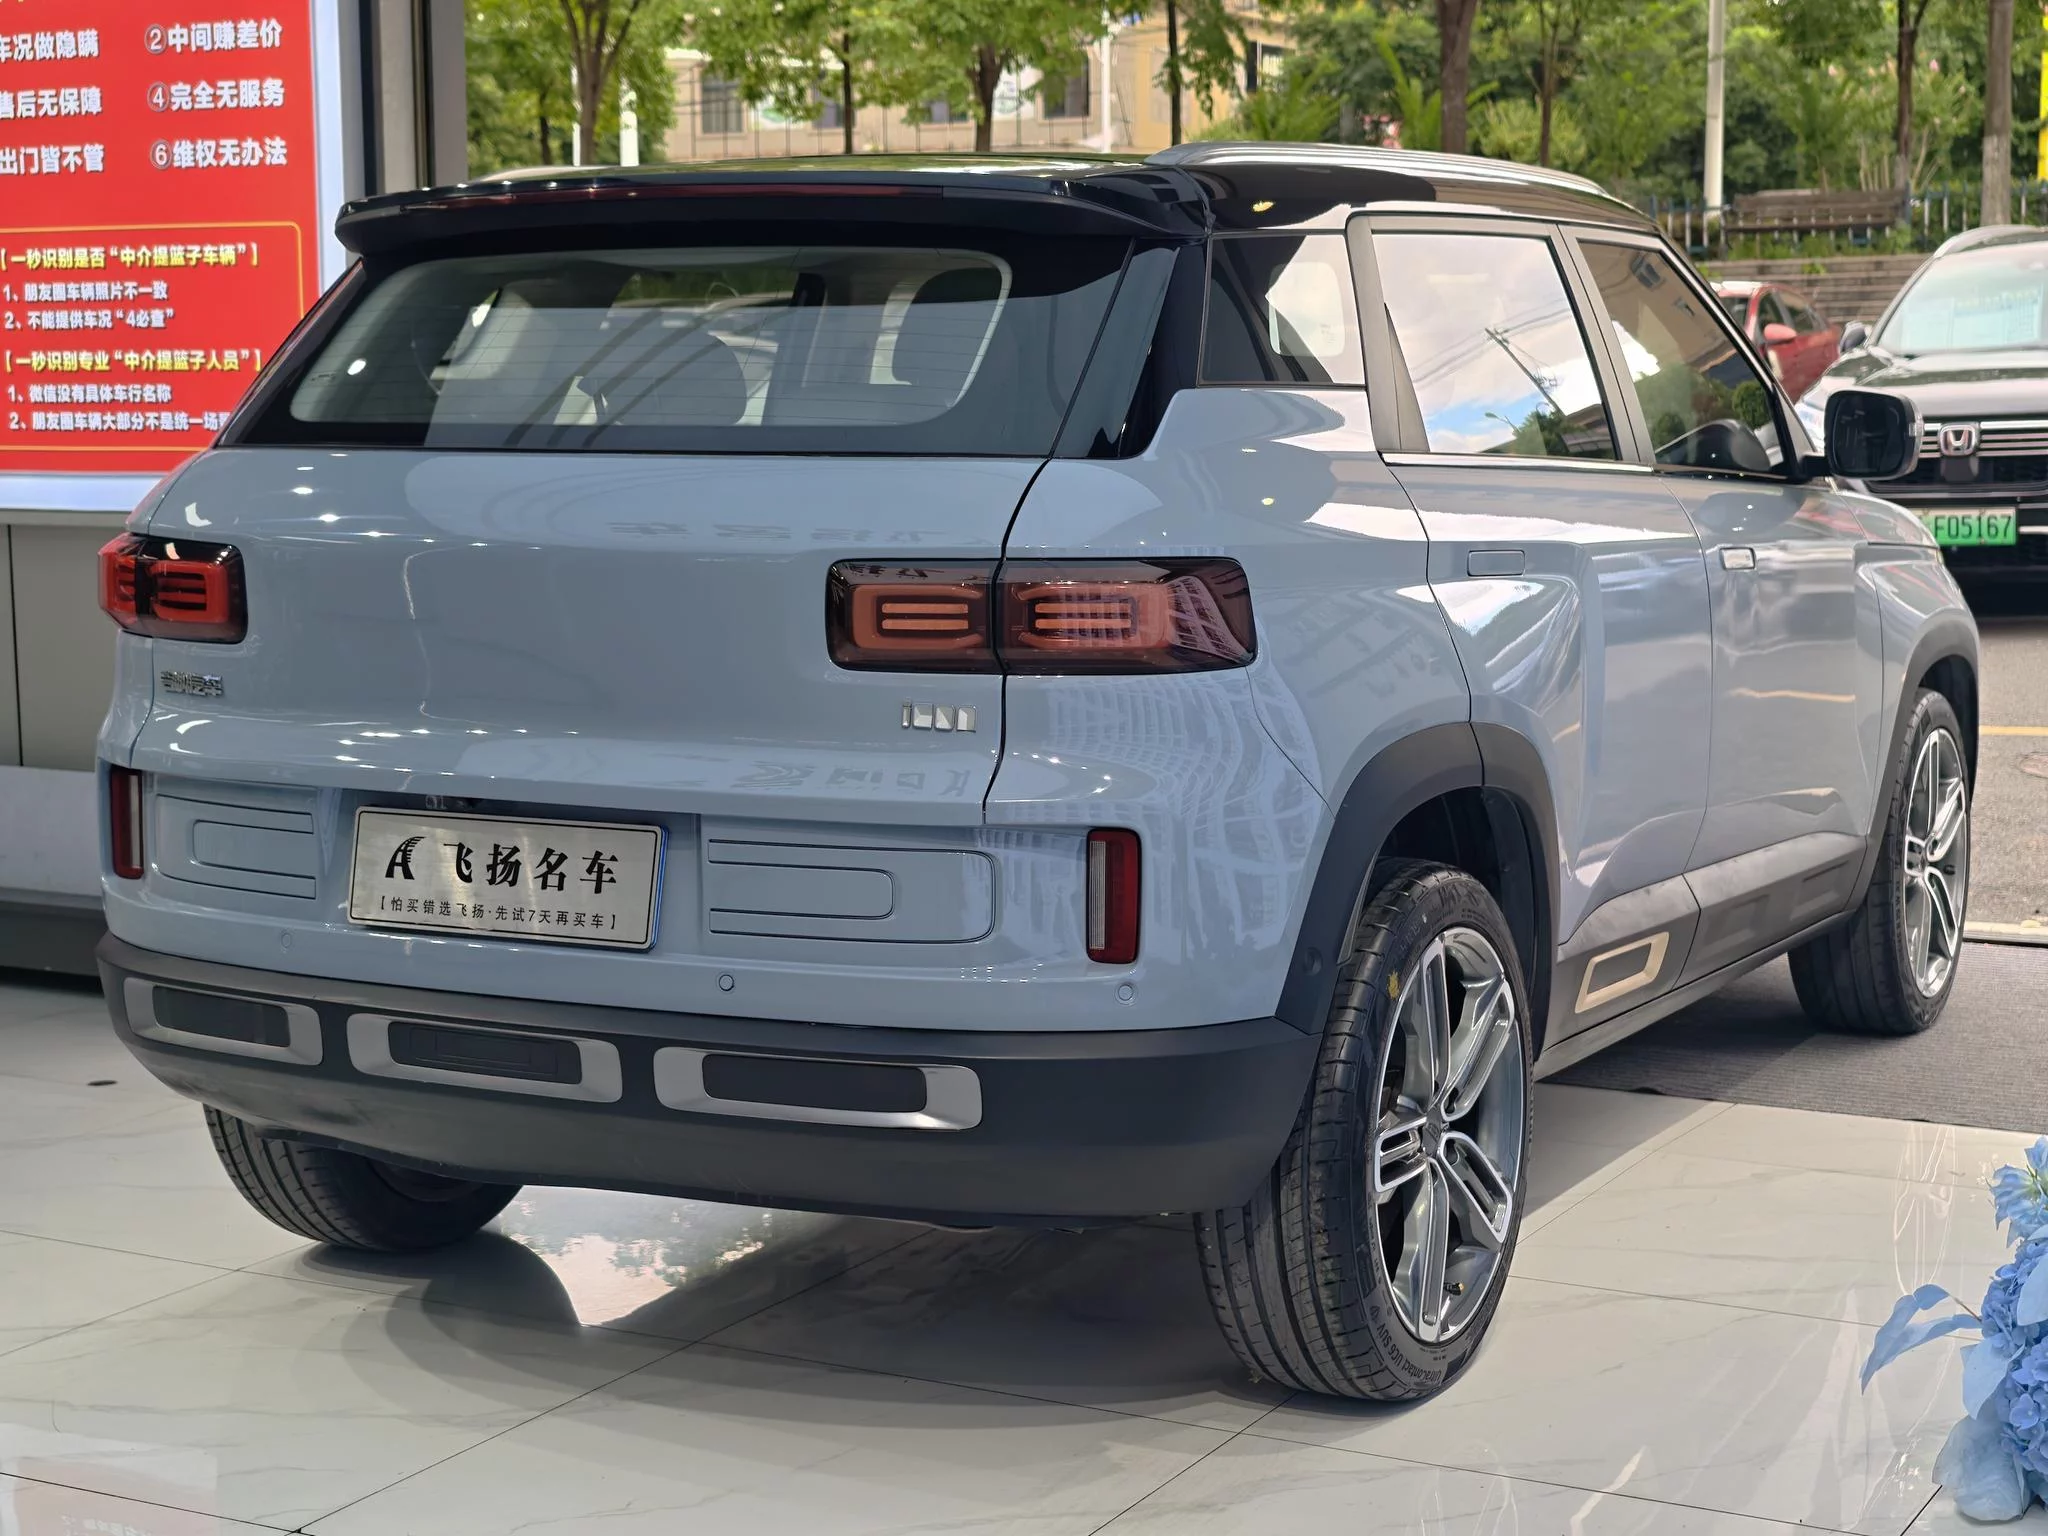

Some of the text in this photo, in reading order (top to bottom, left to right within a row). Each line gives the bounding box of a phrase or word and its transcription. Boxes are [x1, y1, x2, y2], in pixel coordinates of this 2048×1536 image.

[1933, 514, 2012, 539] F05167
[443, 842, 619, 894] 飞扬名车
[1377, 1323, 1392, 1347] SUV
